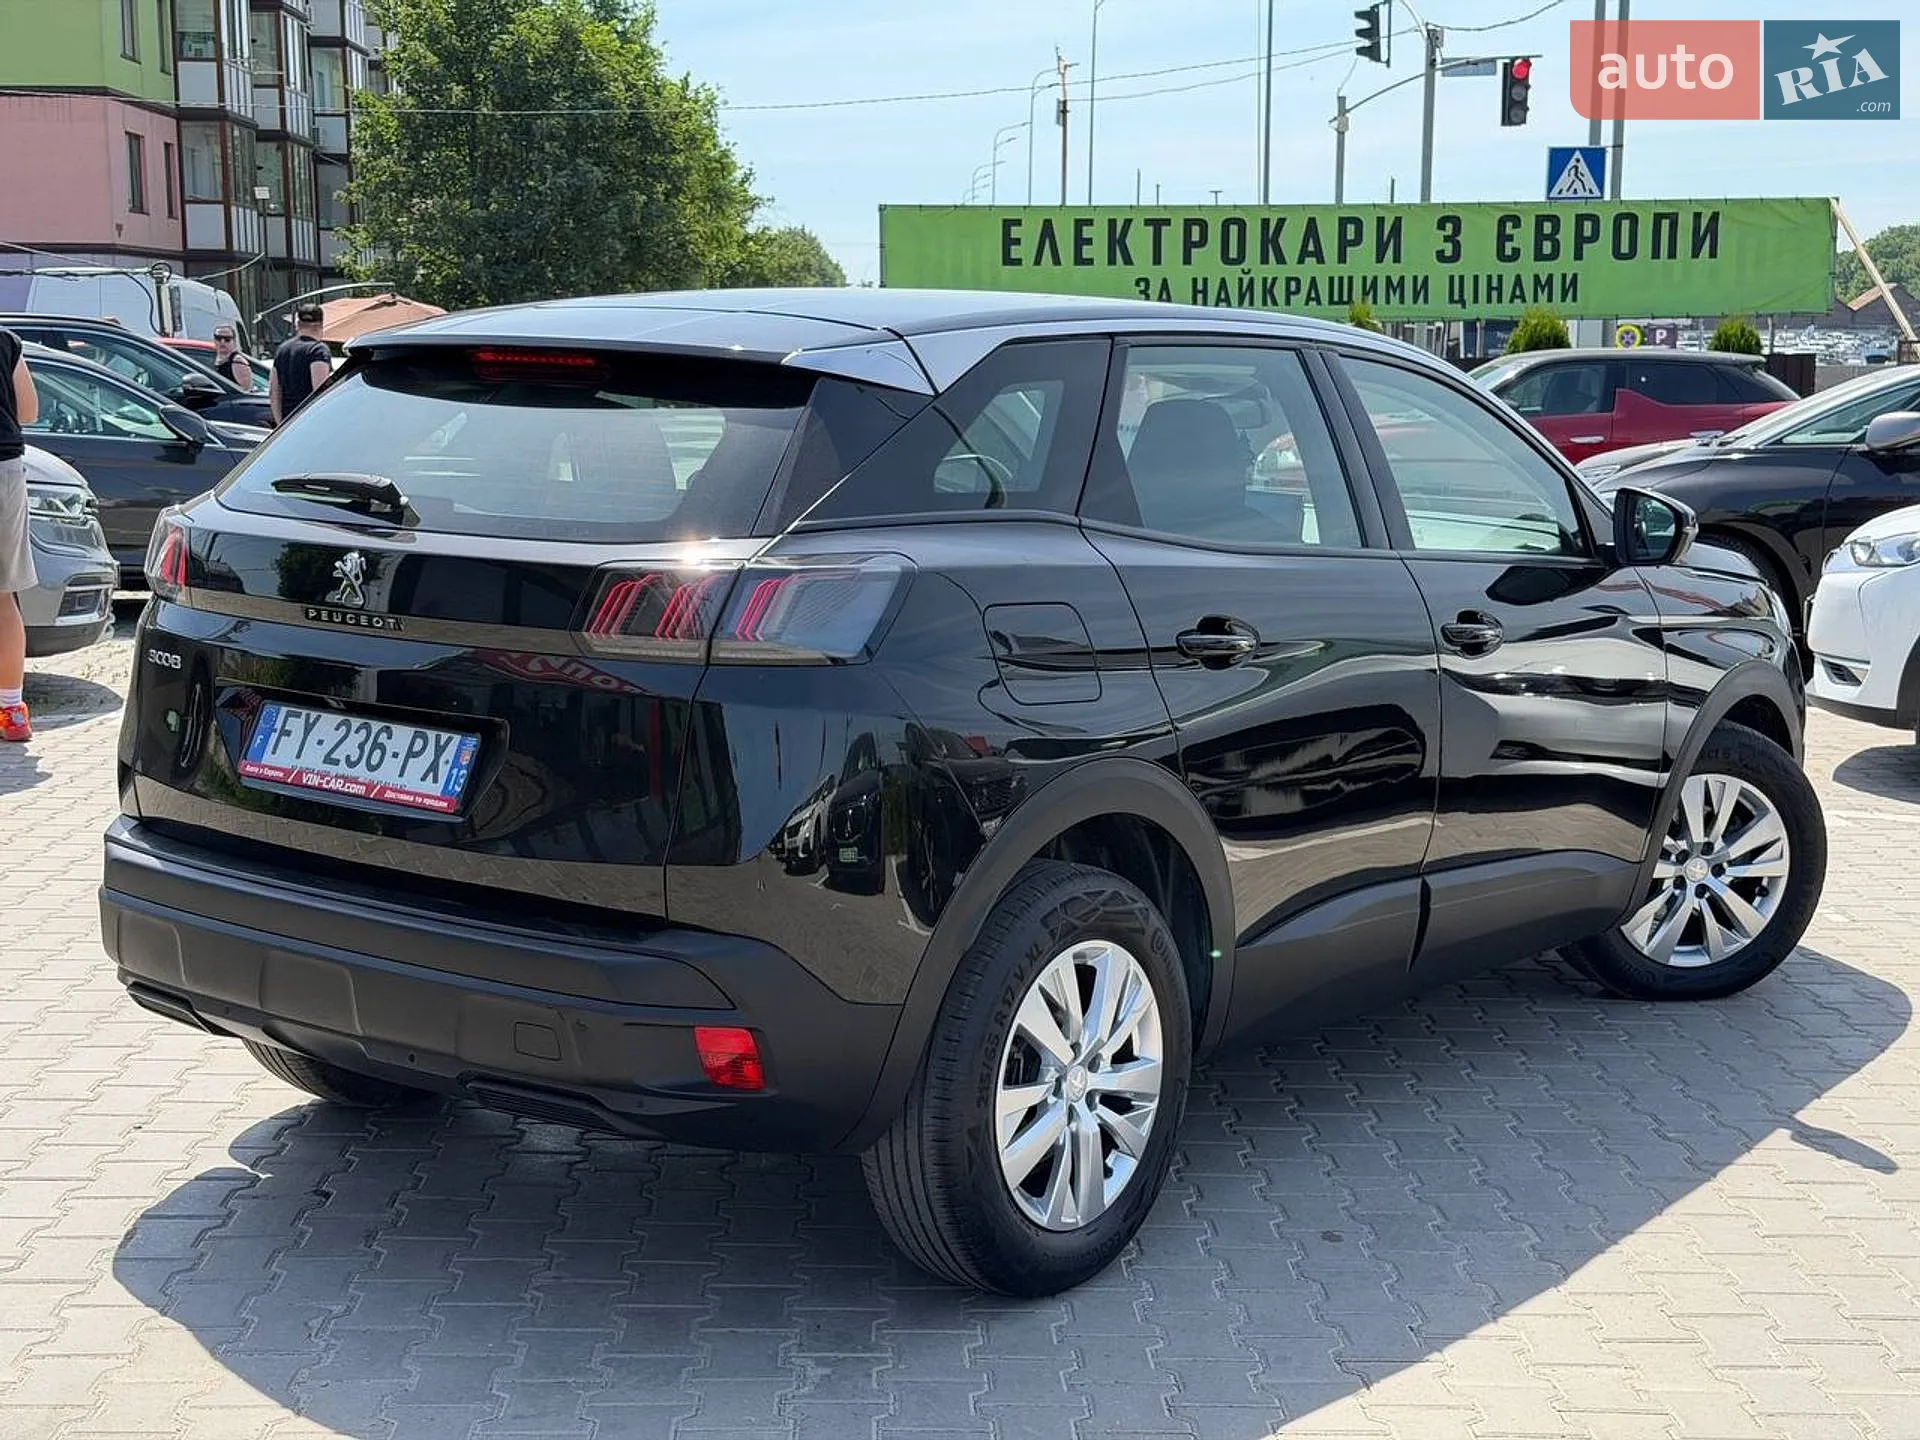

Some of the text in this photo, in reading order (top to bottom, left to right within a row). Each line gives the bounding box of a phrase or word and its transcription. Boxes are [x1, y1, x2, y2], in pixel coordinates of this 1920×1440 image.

[1001, 215, 1402, 267] ЕЛЕКТРОКАРИ
[1495, 211, 1721, 264] ЄВРОПИ
[1134, 277, 1173, 301] ЗА
[1448, 273, 1579, 308] ЦІНАМИ
[307, 607, 397, 631] PEUGEOT
[253, 735, 264, 749] F
[270, 709, 454, 785] FY-236-PX
[447, 767, 466, 796] 13
